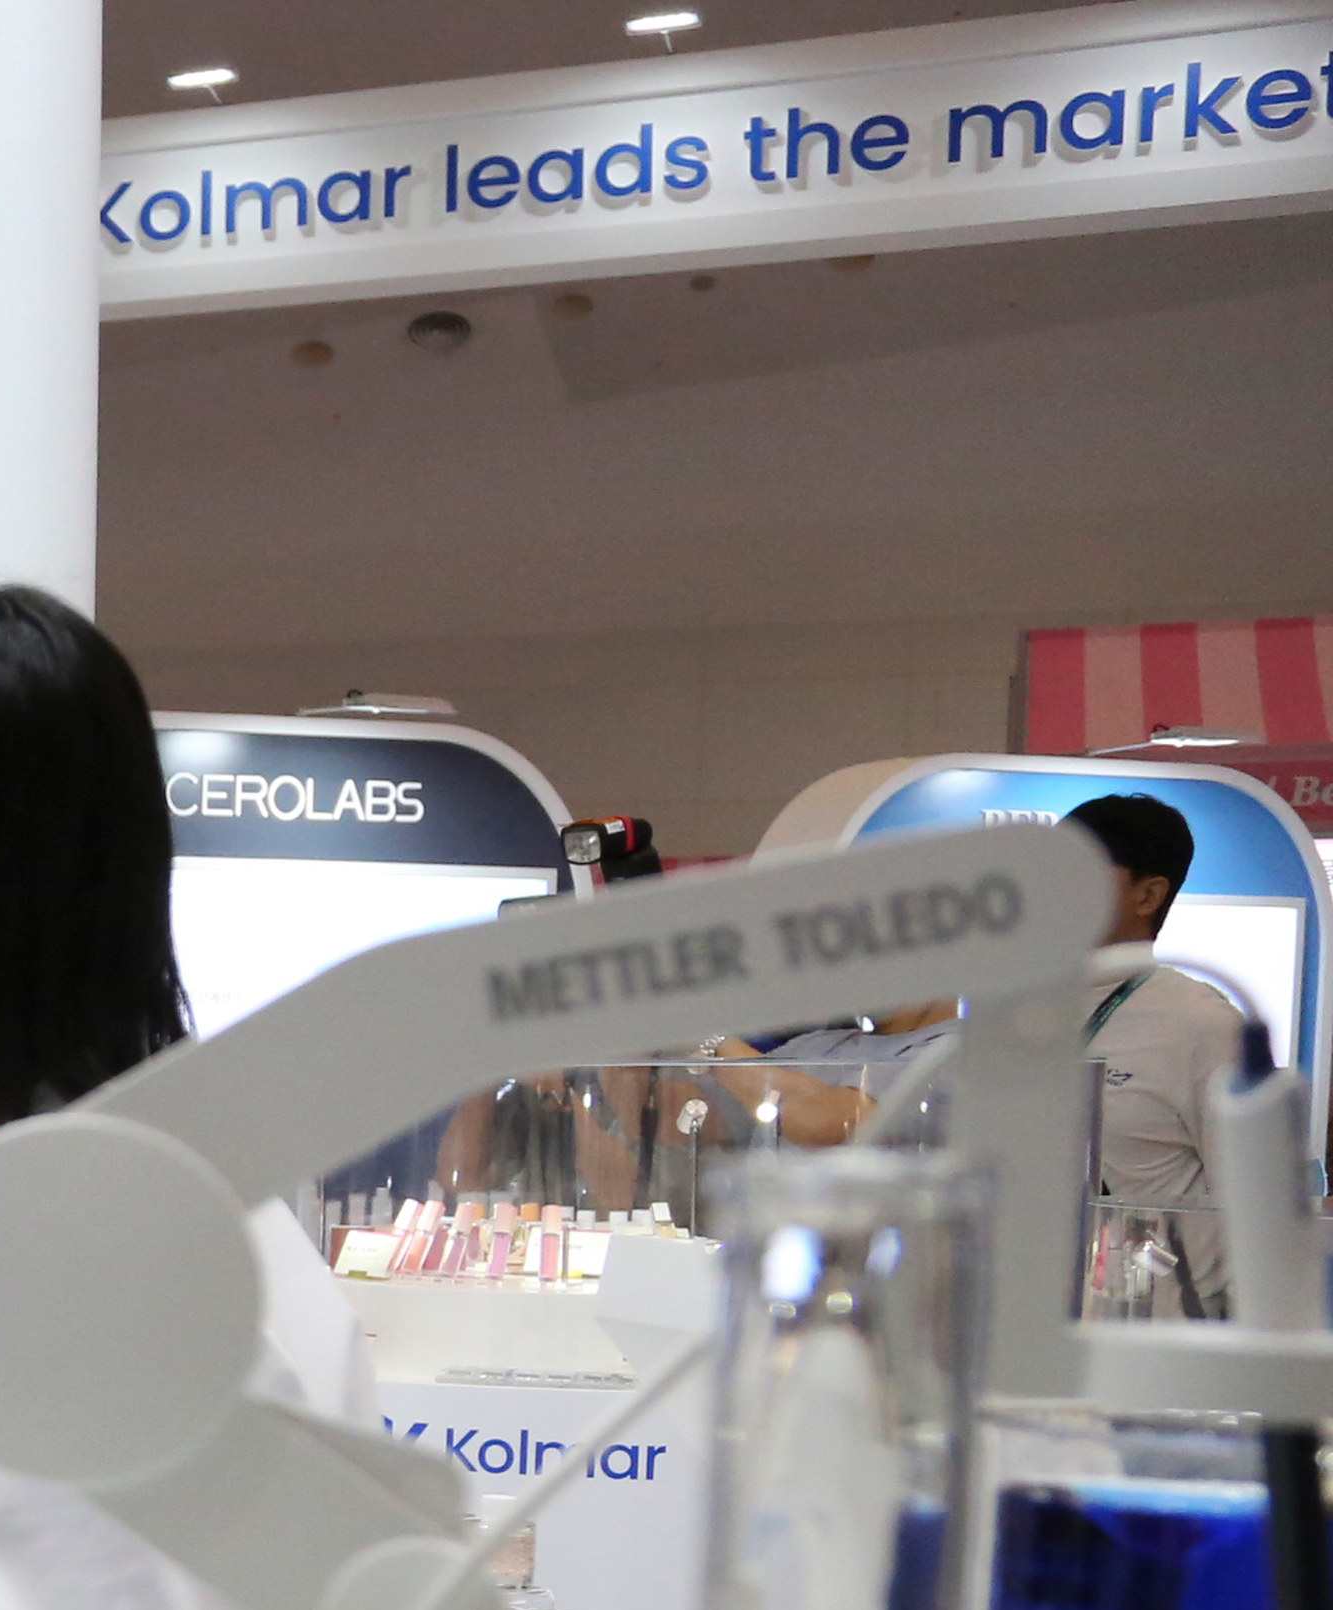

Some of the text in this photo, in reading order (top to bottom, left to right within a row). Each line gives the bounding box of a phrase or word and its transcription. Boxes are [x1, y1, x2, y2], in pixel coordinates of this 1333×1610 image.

[446, 123, 709, 213] leads
[744, 107, 910, 182] the
[165, 772, 425, 823] CEROLABS
[485, 871, 1028, 1022] METTLER TOLEDO
[444, 1427, 667, 1481] Kolmar
